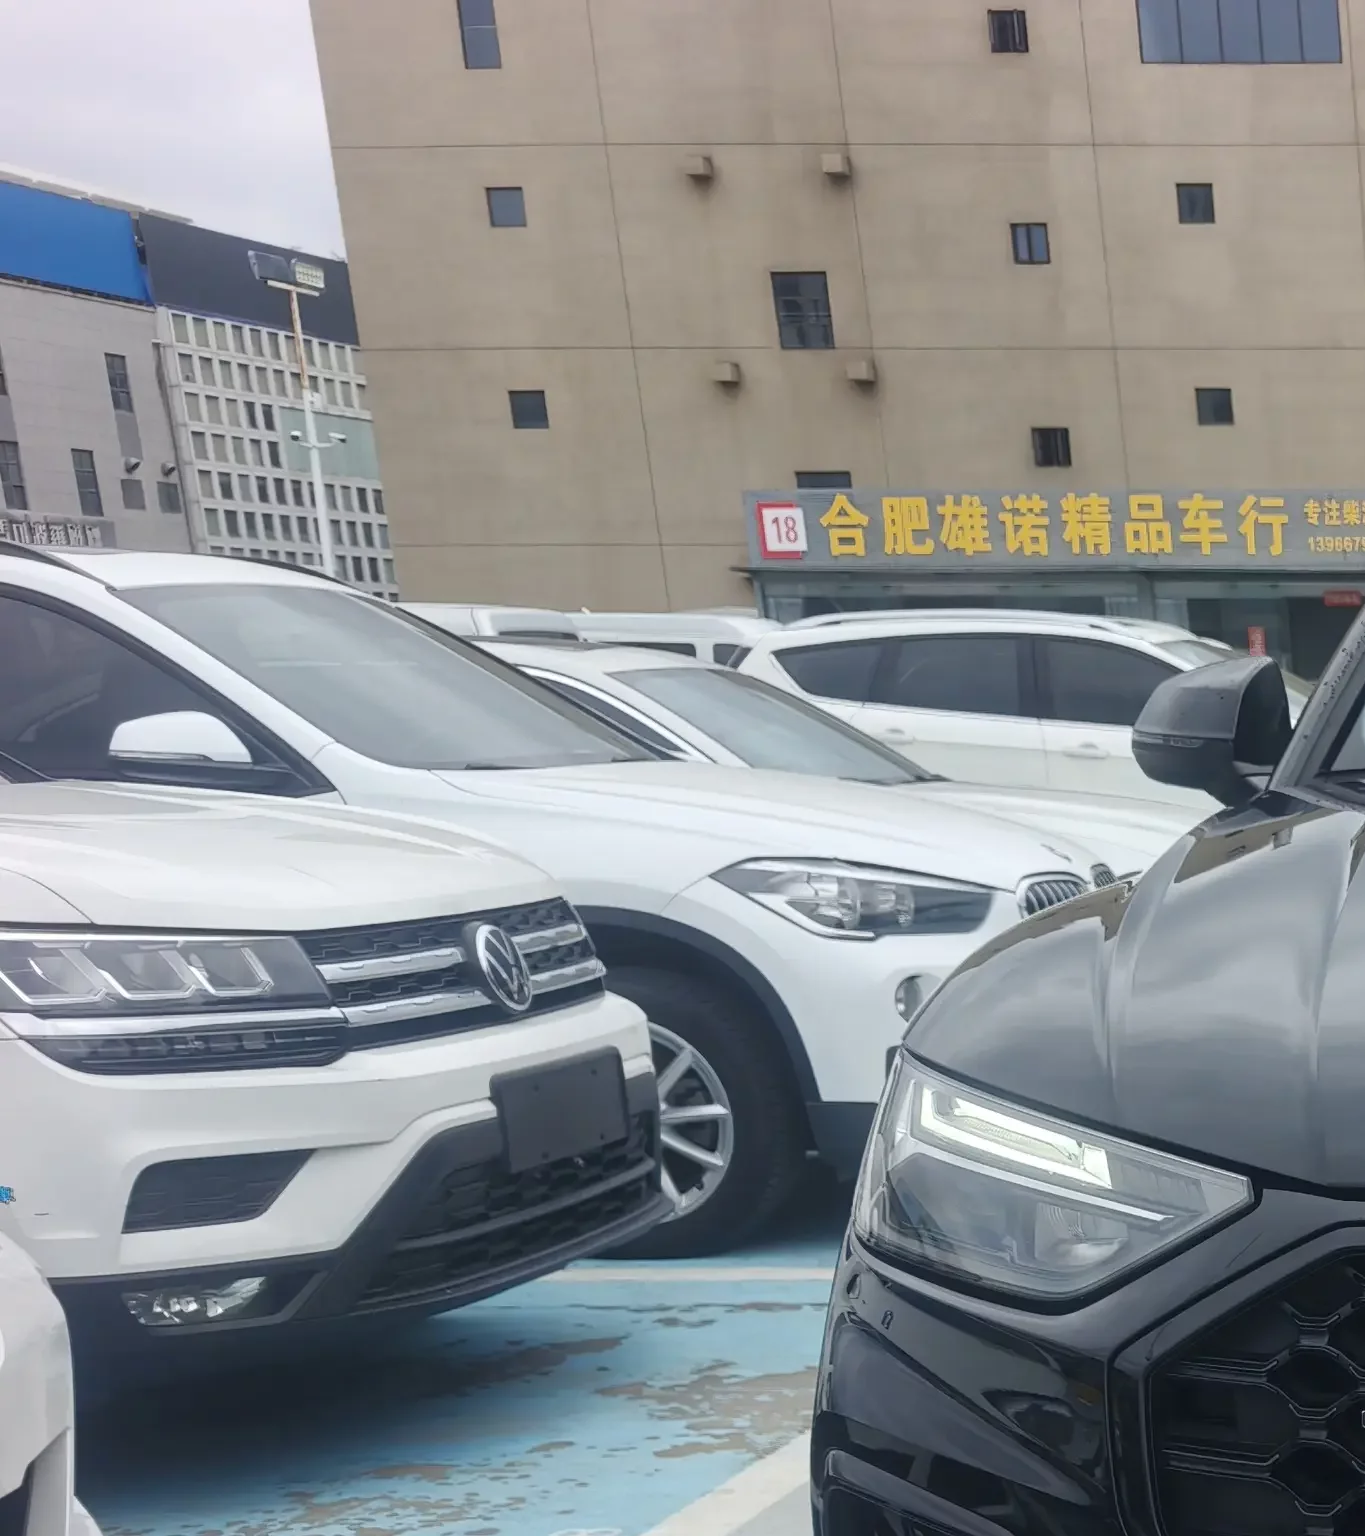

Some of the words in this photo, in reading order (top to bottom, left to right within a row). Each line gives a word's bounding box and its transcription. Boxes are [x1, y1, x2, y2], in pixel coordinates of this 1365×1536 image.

[771, 516, 799, 544] 18
[819, 492, 1289, 557] 合肥雄诺精品车行
